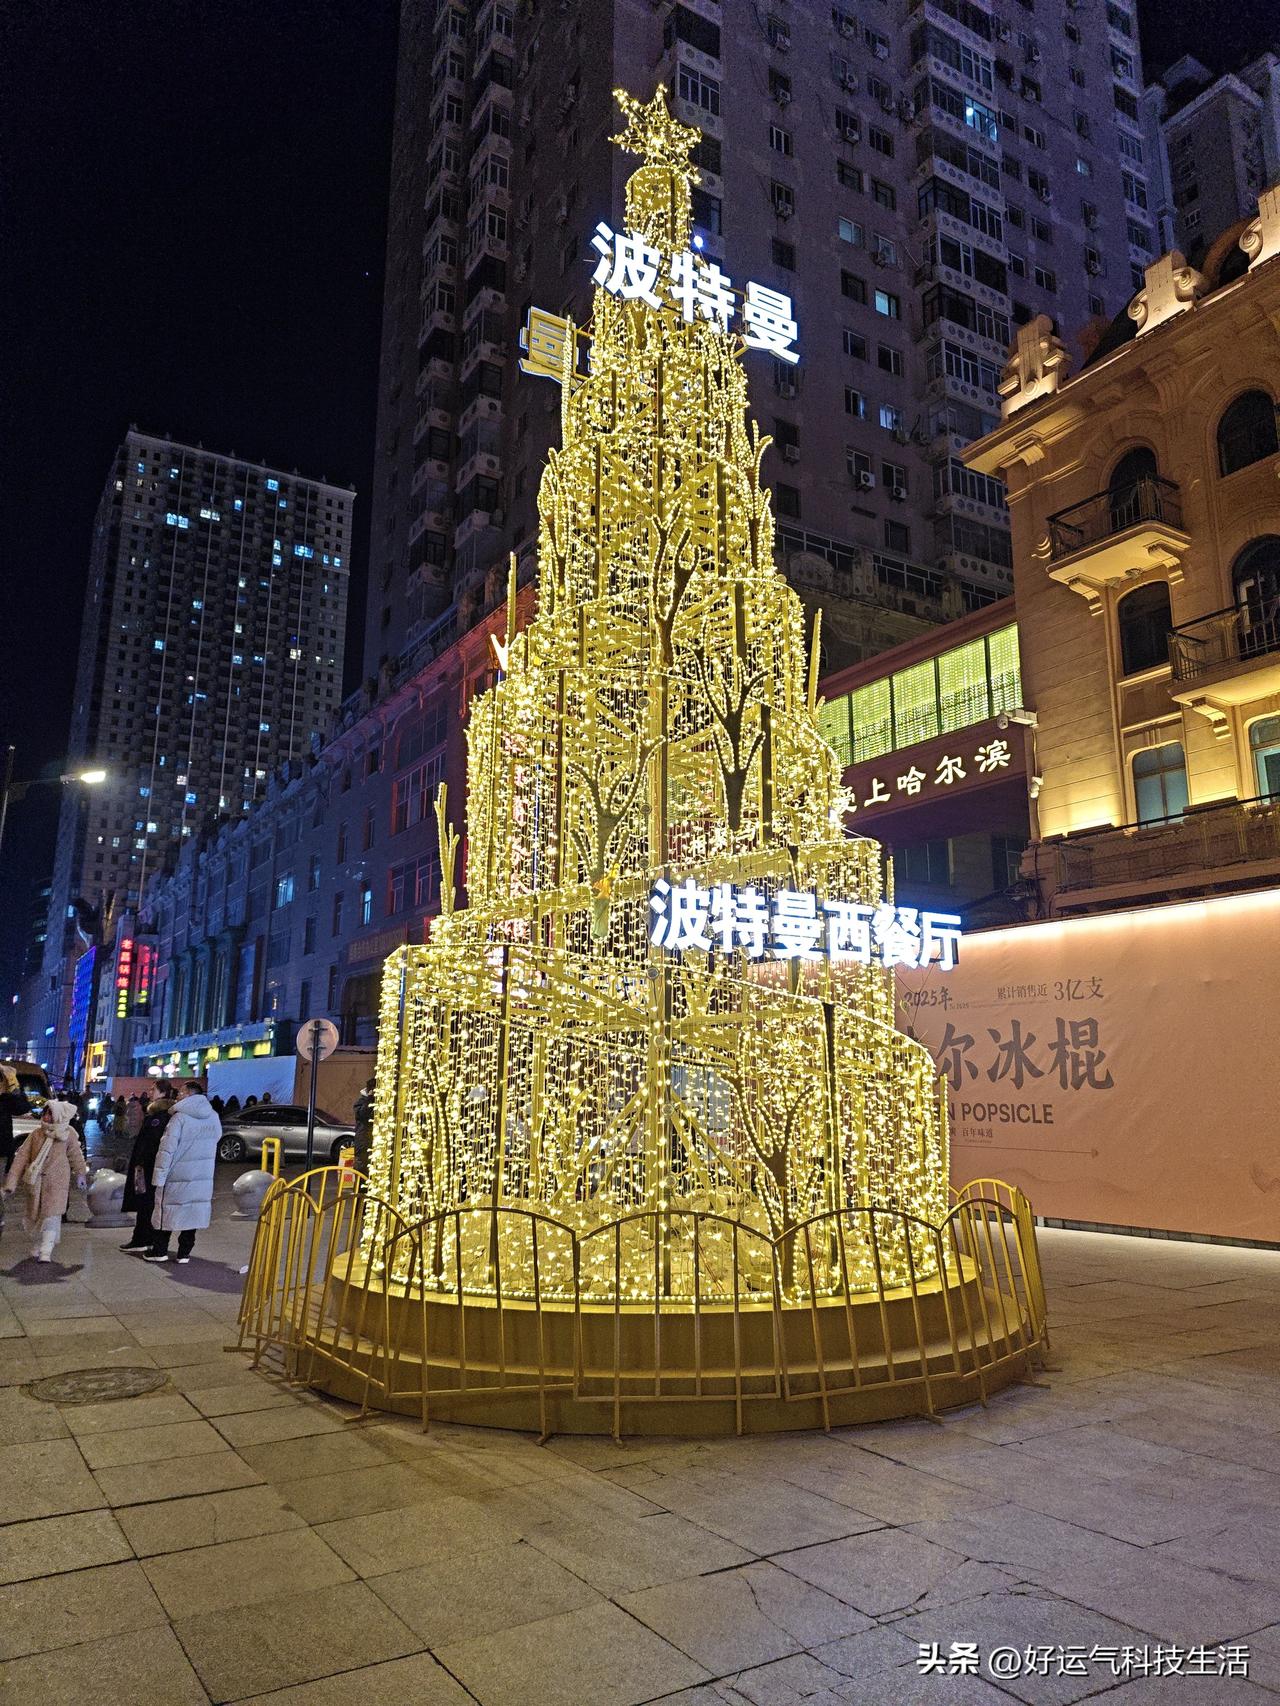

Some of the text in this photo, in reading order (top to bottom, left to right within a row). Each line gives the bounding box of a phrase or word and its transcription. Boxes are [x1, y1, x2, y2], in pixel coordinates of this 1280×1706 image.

[591, 221, 800, 365] 波特曼
[832, 739, 1011, 814] 爱上哈尔滨
[650, 878, 962, 972] 波特曼西餐厅
[1054, 976, 1104, 1001] 3亿支
[907, 1016, 1114, 1092] 尔冰棍
[961, 1102, 1054, 1124] POPSICLE
